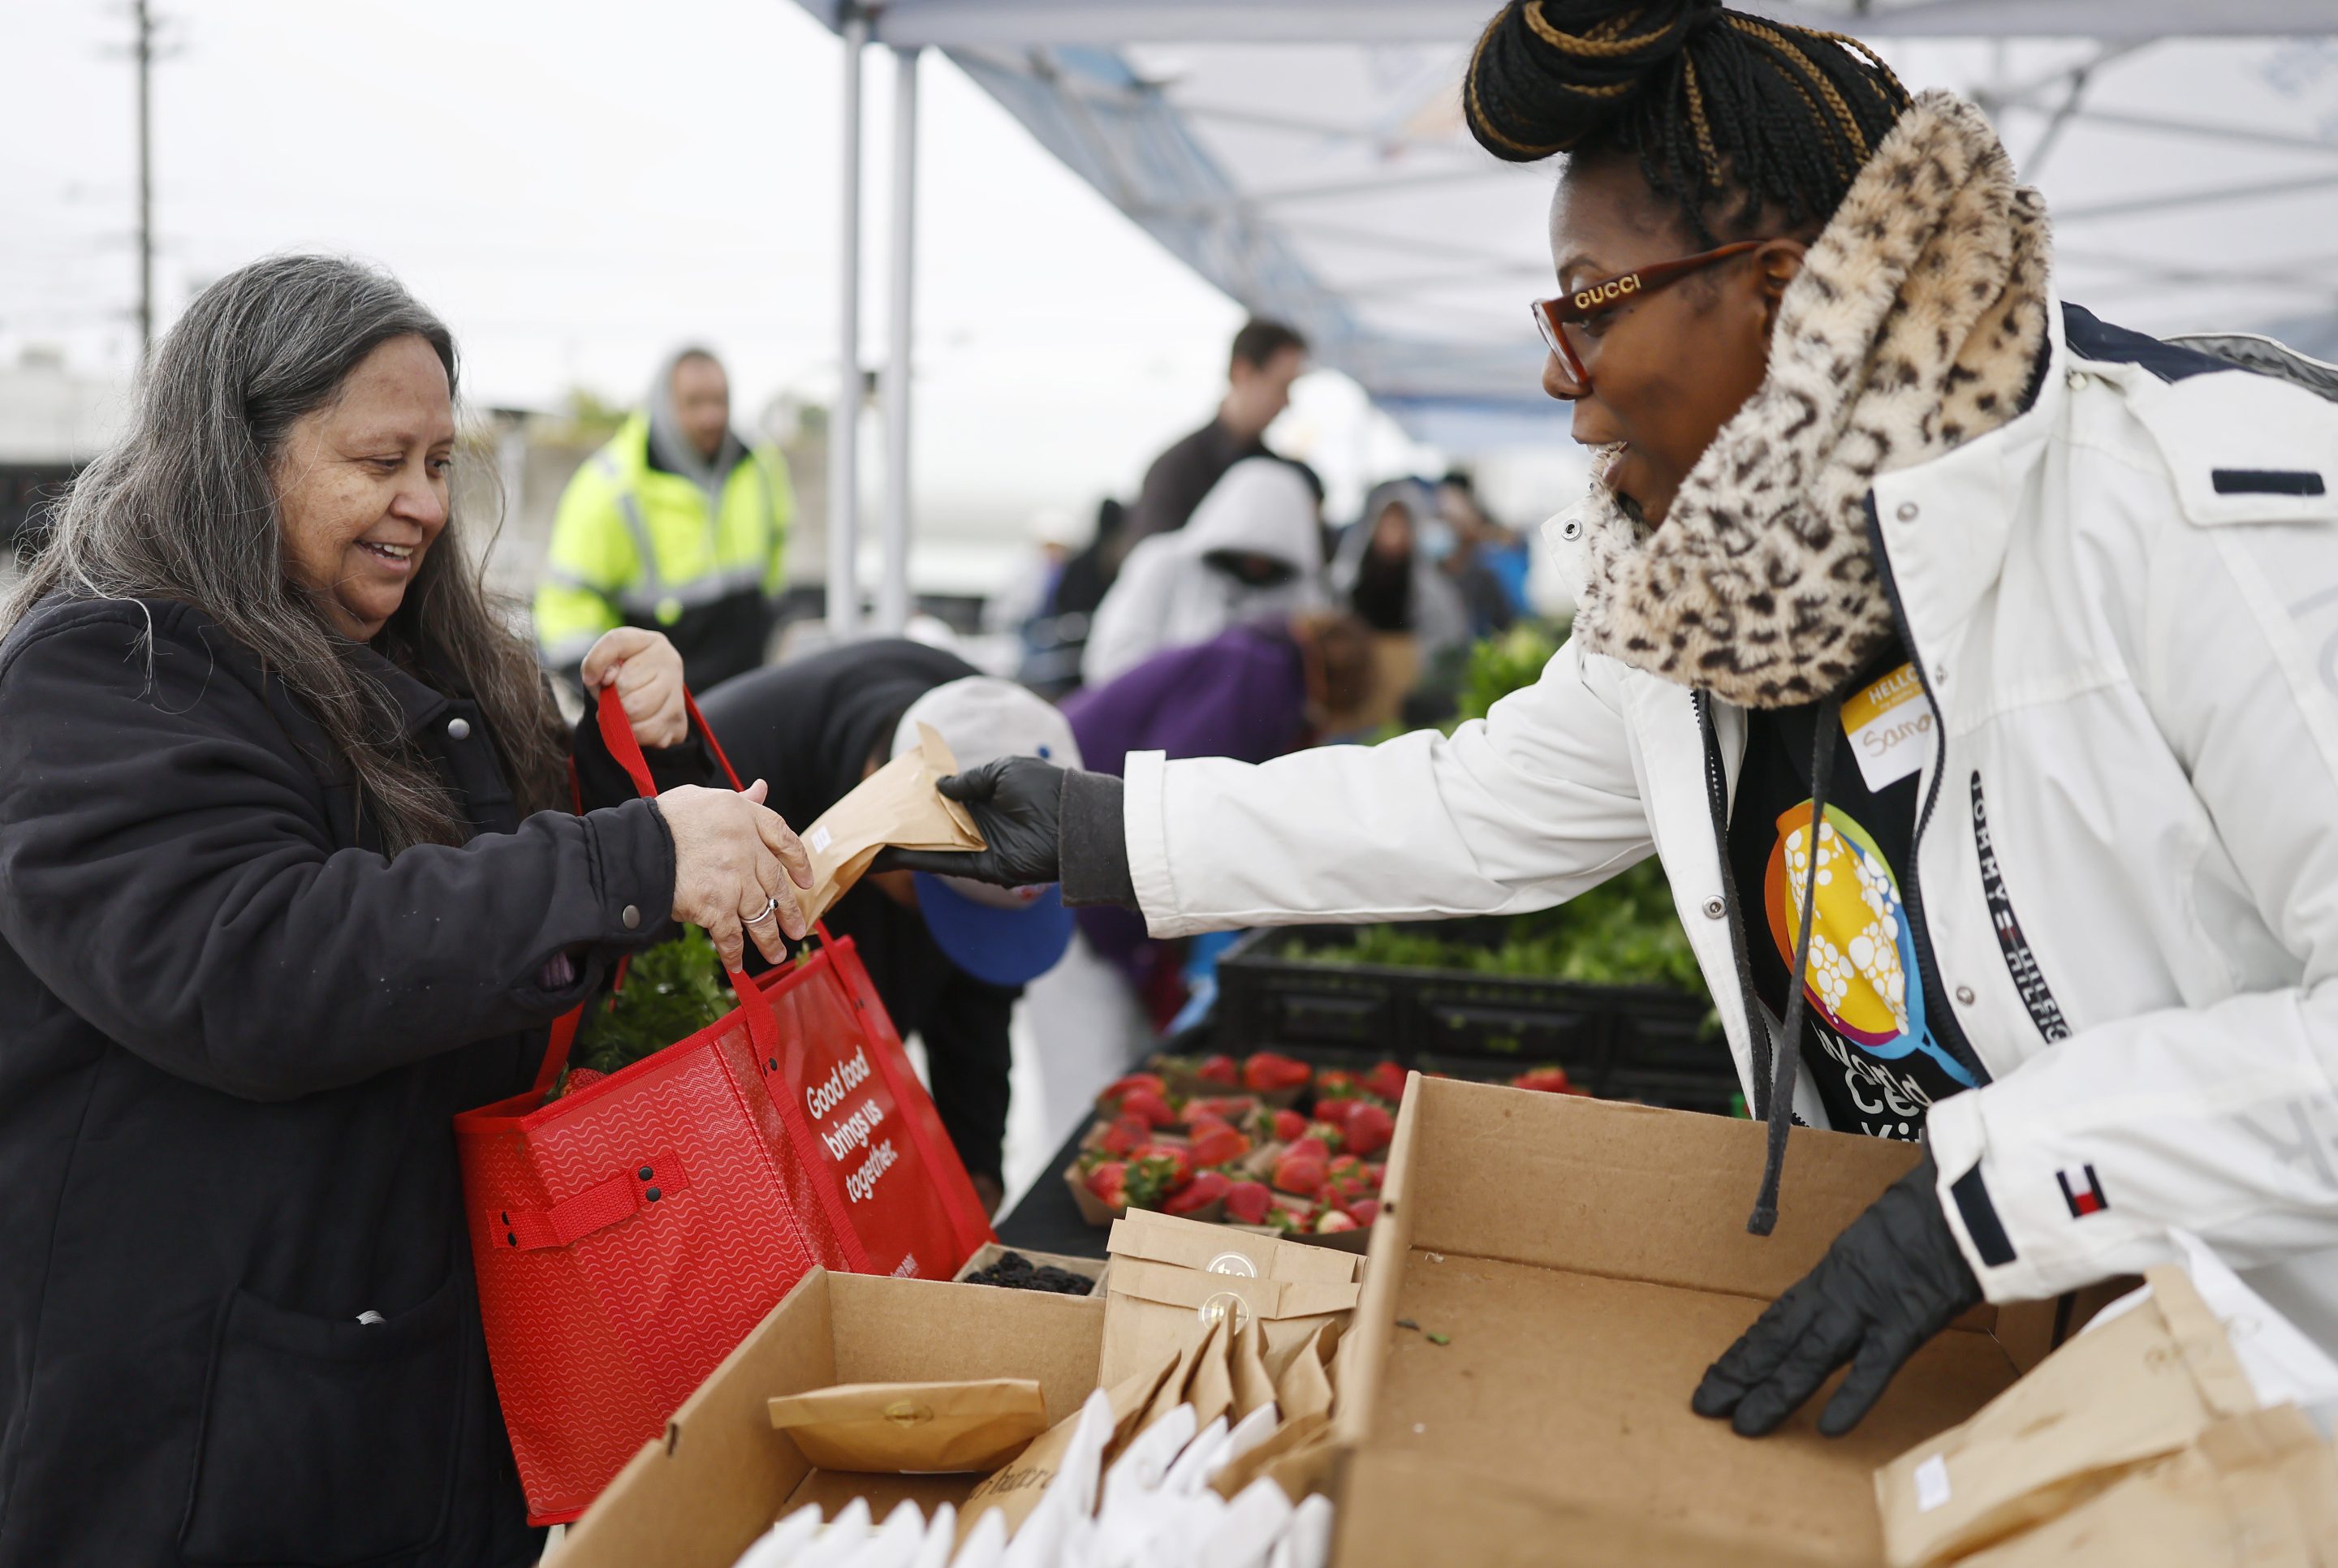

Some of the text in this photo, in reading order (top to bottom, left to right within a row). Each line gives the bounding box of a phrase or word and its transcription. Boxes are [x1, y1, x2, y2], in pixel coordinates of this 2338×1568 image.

[1574, 274, 1641, 309] GUCCI
[1970, 781, 2008, 902] TOMMY
[807, 1045, 870, 1120] Good food
[1810, 1019, 1934, 1109] World
[821, 1098, 884, 1161] brings us
[846, 1138, 899, 1204] together.
